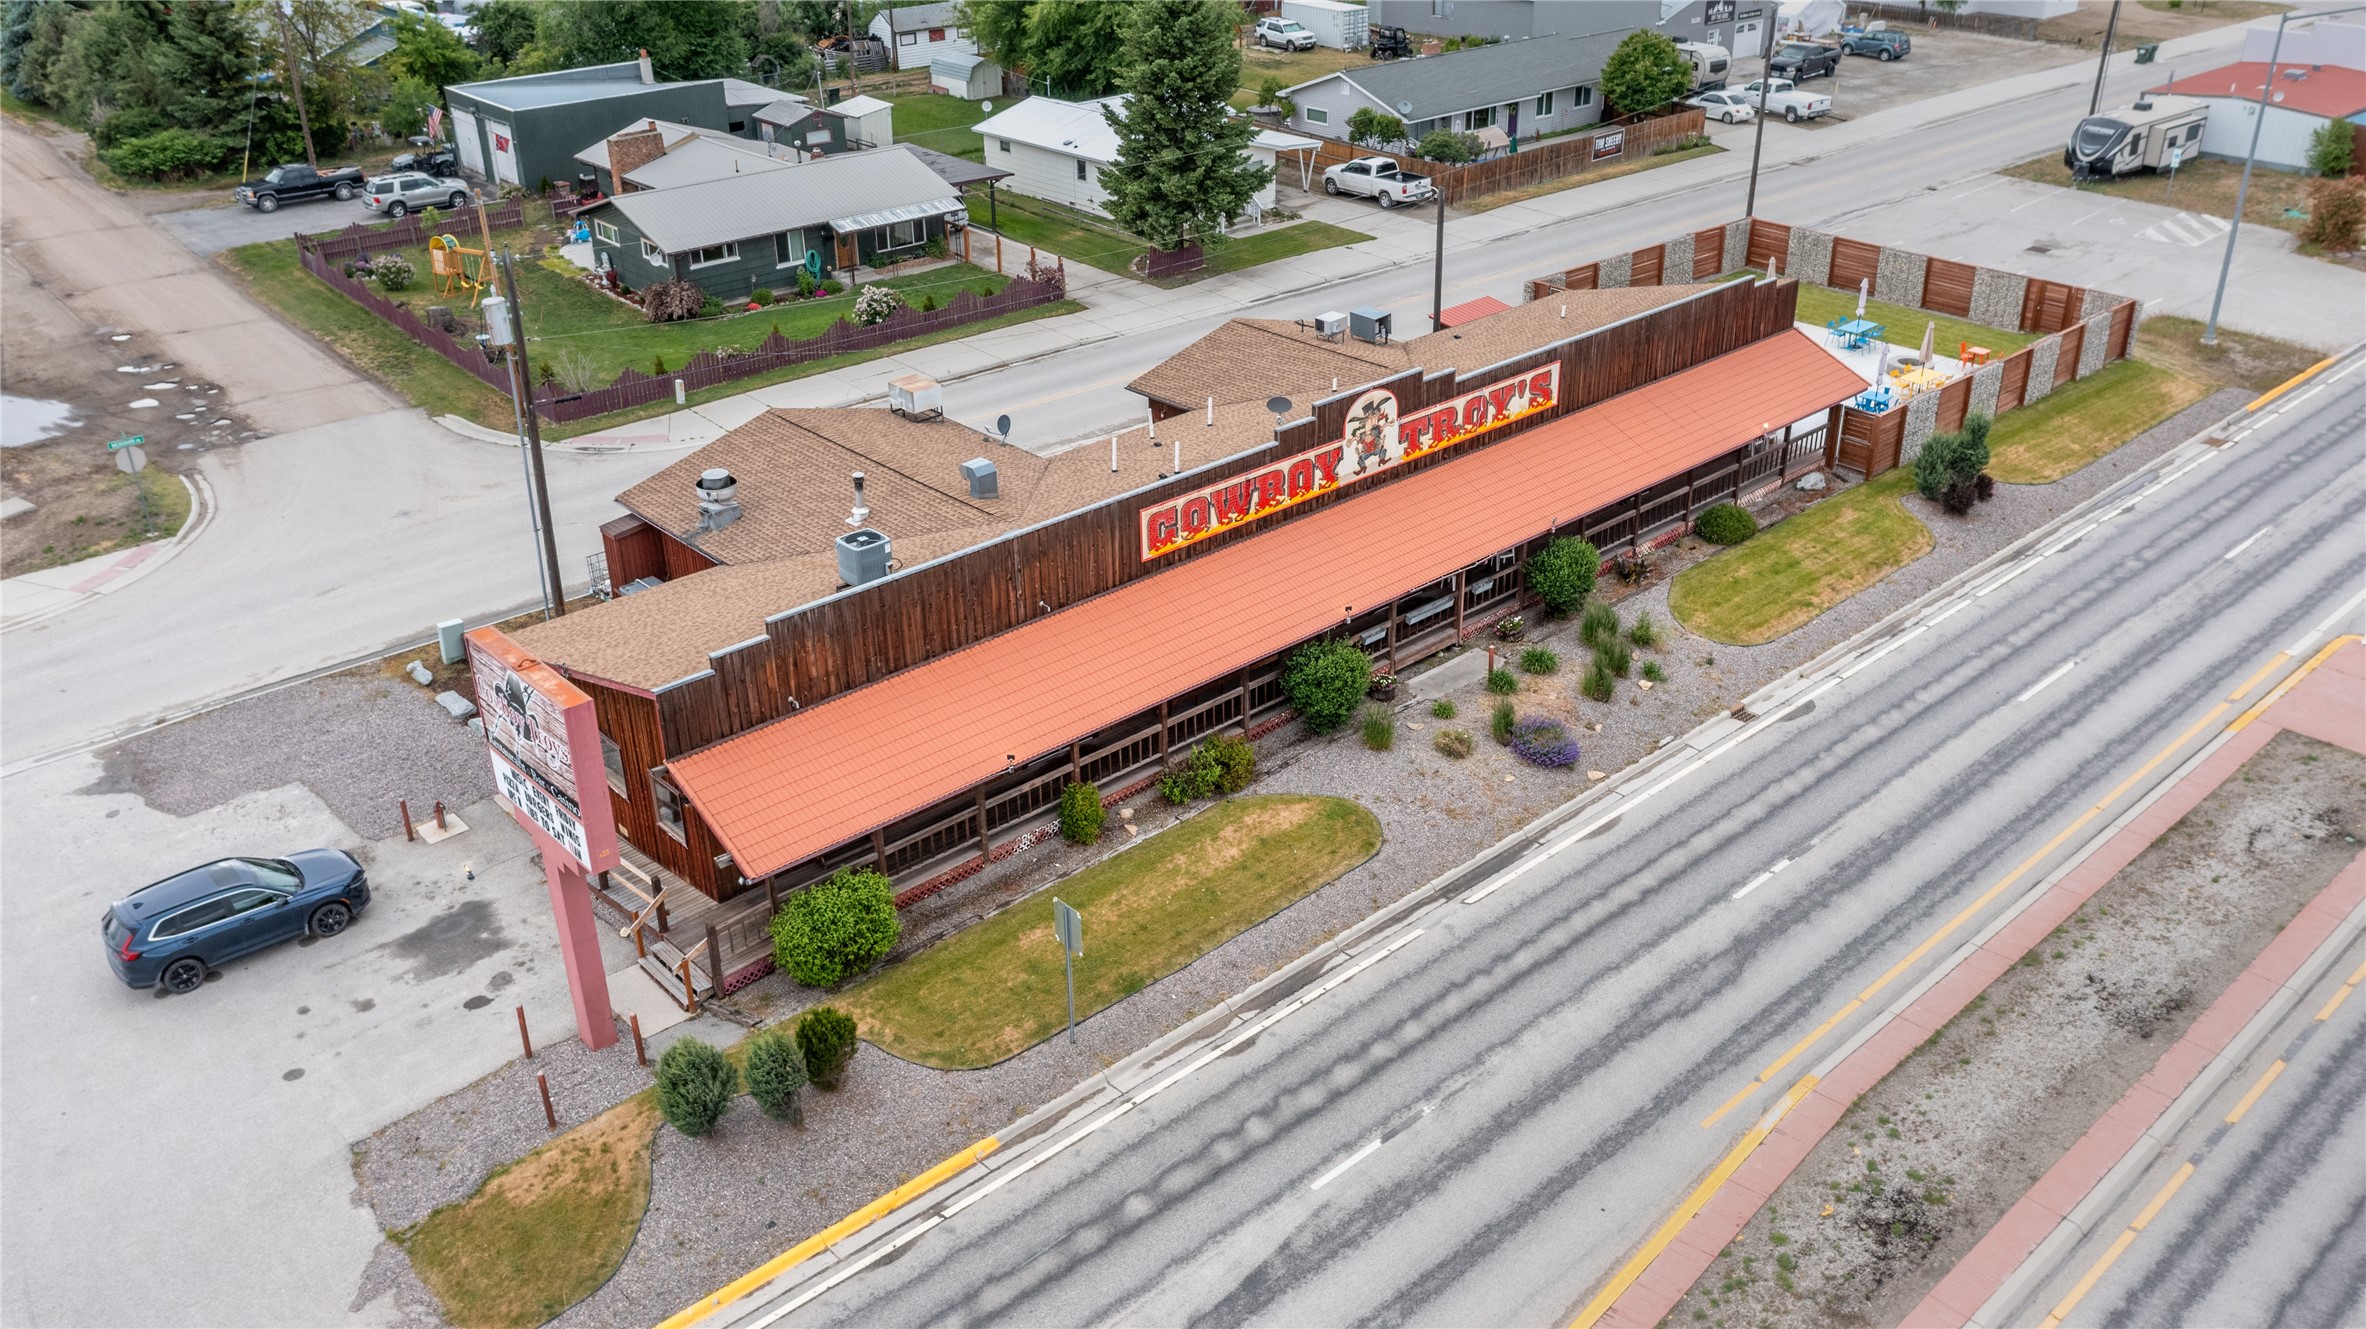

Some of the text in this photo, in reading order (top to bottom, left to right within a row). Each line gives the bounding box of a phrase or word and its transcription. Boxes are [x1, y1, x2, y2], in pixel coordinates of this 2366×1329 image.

[1147, 369, 1553, 556] COWBOY TROY'S
[502, 772, 581, 848] PIZZA BURGERS WINGS
[510, 767, 576, 831] MUSIC EVERY FRIDAY
[526, 803, 539, 823] TUES
[541, 816, 550, 832] TO
[552, 827, 566, 846] SAT
[530, 770, 546, 788] Bar
[550, 785, 581, 817] Casino
